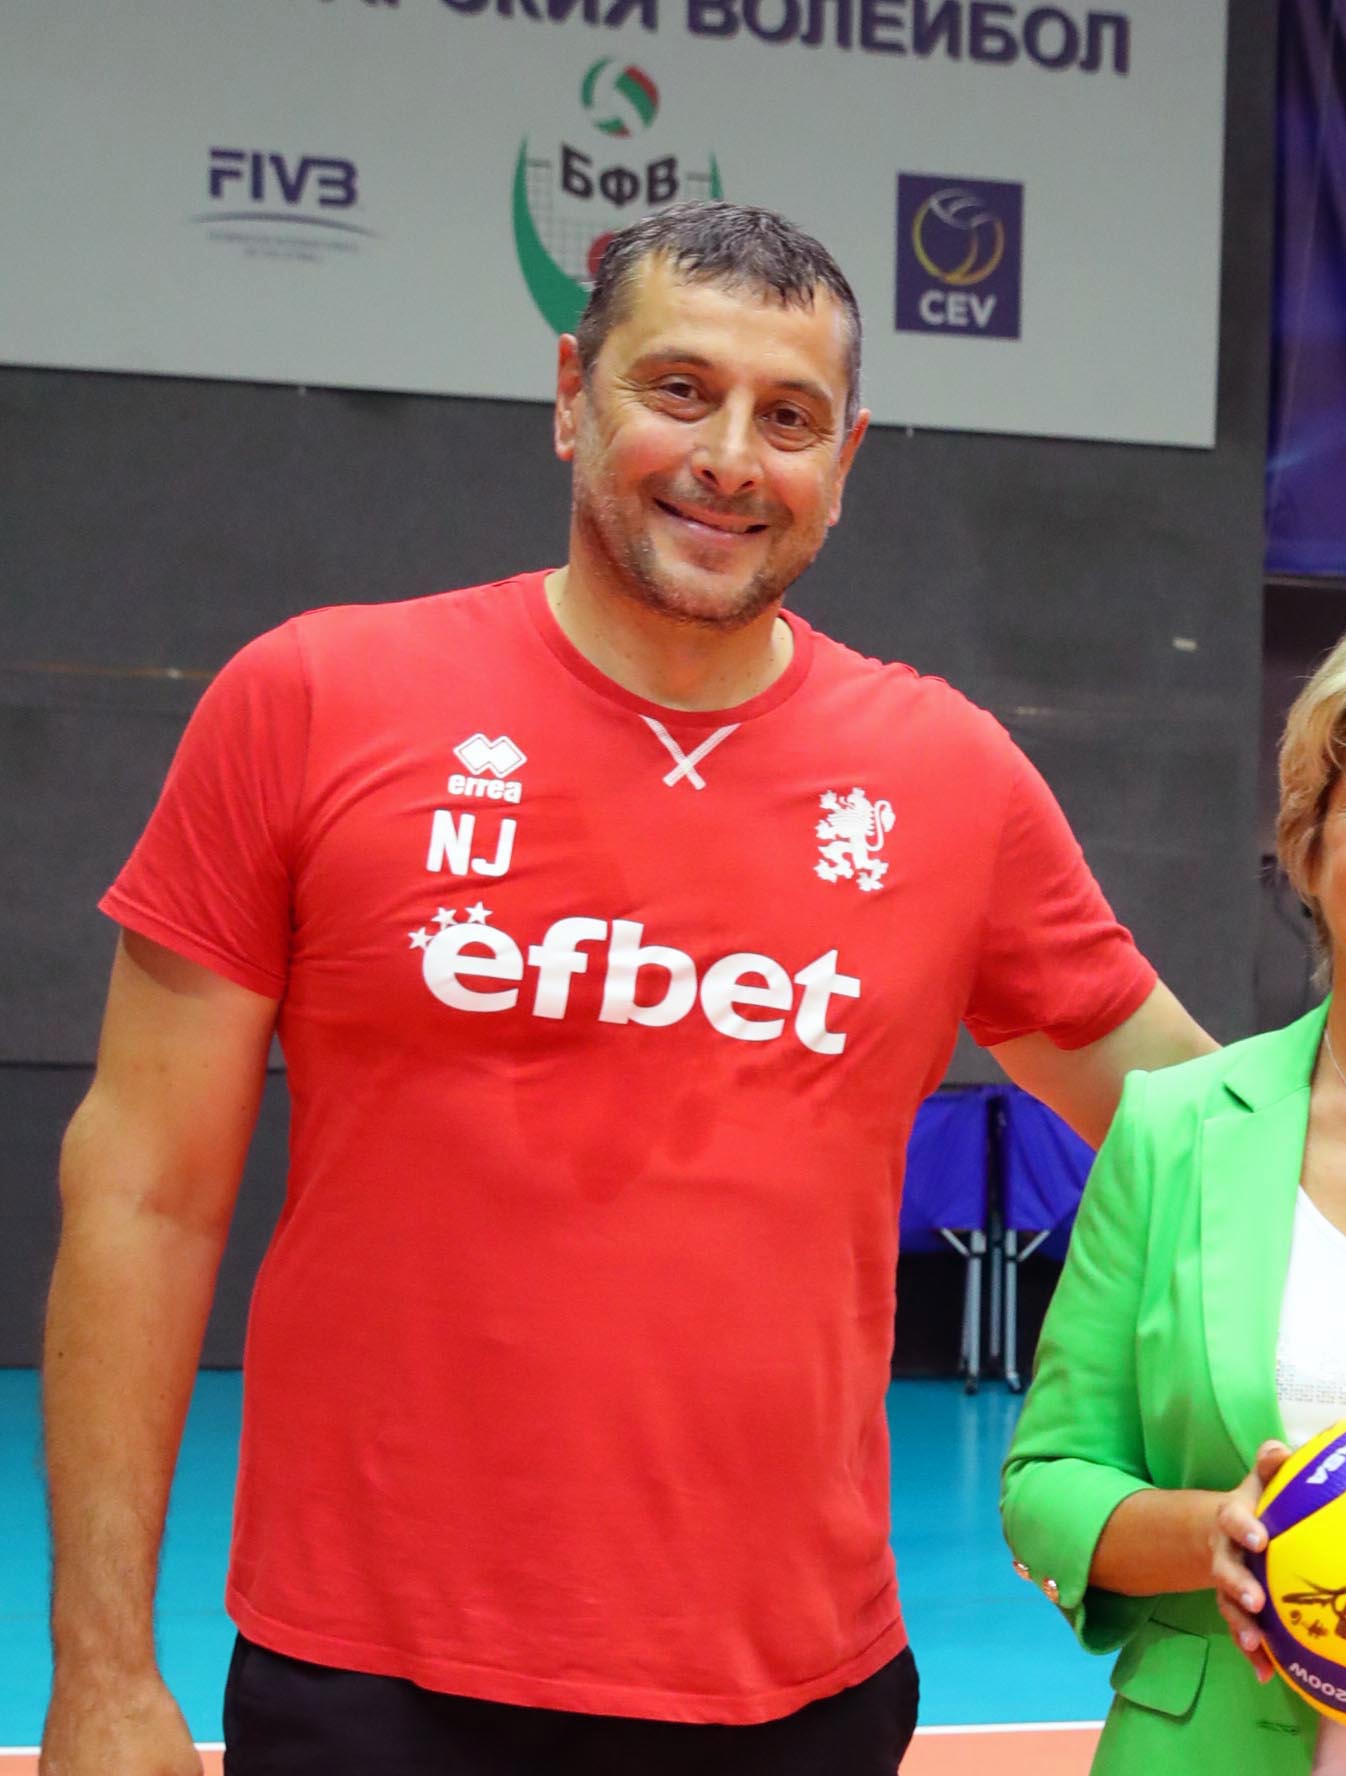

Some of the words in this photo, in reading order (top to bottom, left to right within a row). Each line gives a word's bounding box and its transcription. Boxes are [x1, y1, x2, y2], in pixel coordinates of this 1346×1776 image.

[209, 148, 358, 209] FIVB
[561, 142, 680, 208] БФВ
[919, 289, 997, 329] CEV
[425, 809, 517, 877] NJ
[421, 916, 862, 1055] efbet
